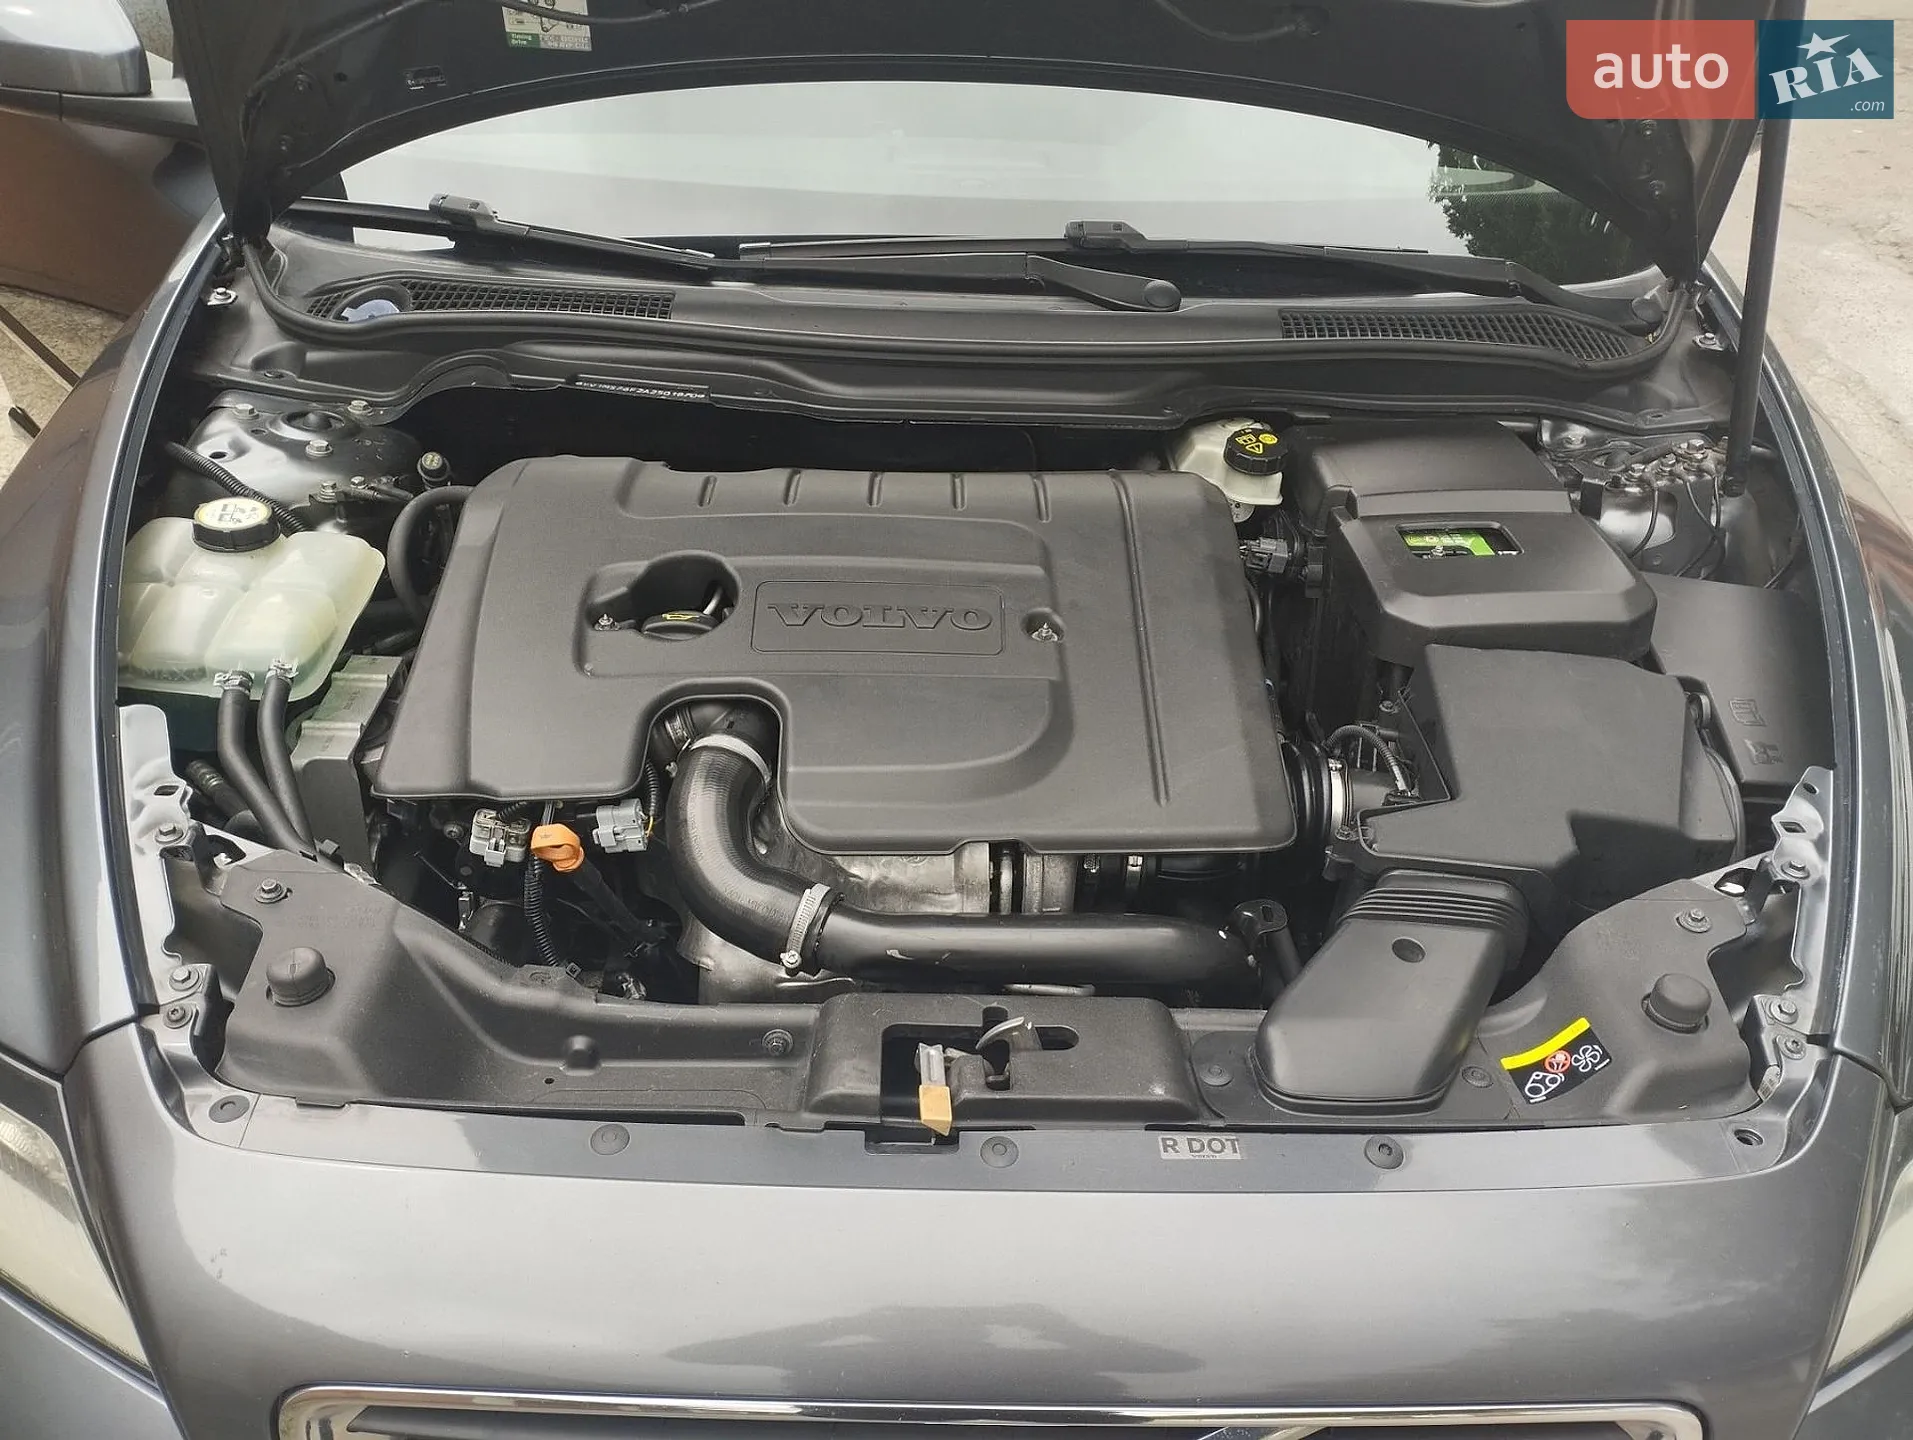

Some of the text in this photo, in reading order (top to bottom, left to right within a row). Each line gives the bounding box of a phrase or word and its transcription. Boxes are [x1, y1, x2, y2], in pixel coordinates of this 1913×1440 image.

[767, 602, 993, 632] VOLVO
[1161, 1137, 1240, 1154] R DOT
